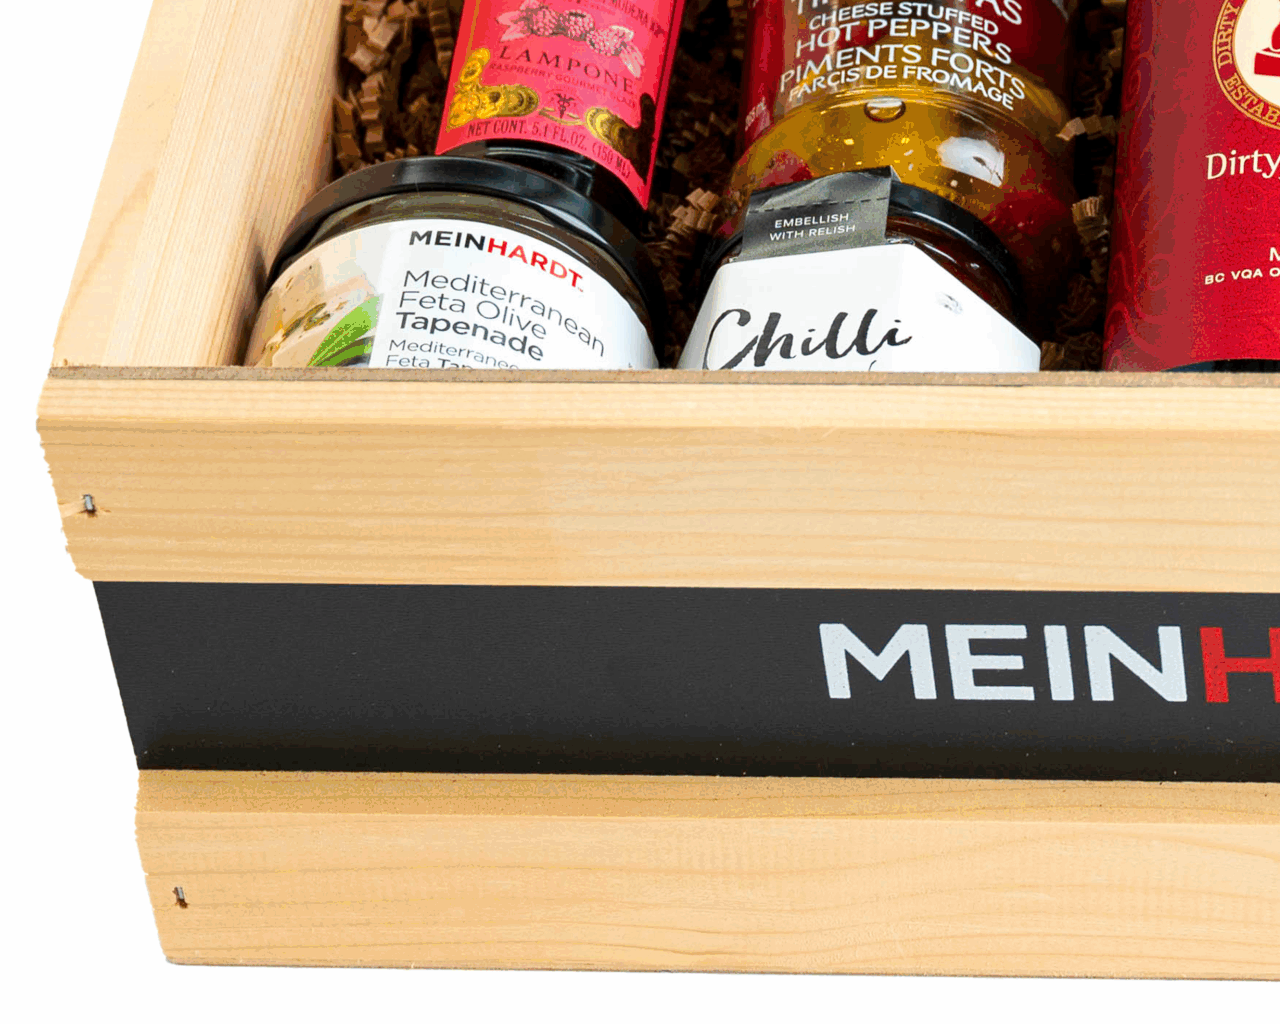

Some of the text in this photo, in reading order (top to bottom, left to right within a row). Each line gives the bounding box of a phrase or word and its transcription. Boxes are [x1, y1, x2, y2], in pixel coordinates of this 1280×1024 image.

[796, 18, 1012, 65] HOT PEPPERS
[809, 1, 999, 36] CHEESE STUFFED
[1216, 2, 1241, 69] DIRTY
[500, 46, 635, 94] LAMPONE
[779, 44, 1026, 100] PIMENTS FORTS
[788, 64, 1014, 111] FARCIS DE FROMAGE
[467, 121, 489, 138] NET
[493, 119, 527, 135] CONT.
[769, 224, 856, 242] WITH RELISH
[775, 212, 849, 229] EMBELLISH
[408, 230, 584, 290] MEINHARDT
[1204, 272, 1225, 285] BC
[1231, 268, 1263, 280] VQA
[395, 311, 545, 362] Tapenade
[399, 291, 547, 340] Feta Olive
[403, 270, 605, 358] Mediterranean
[385, 355, 430, 369] Feta
[704, 308, 914, 370] Chilli
